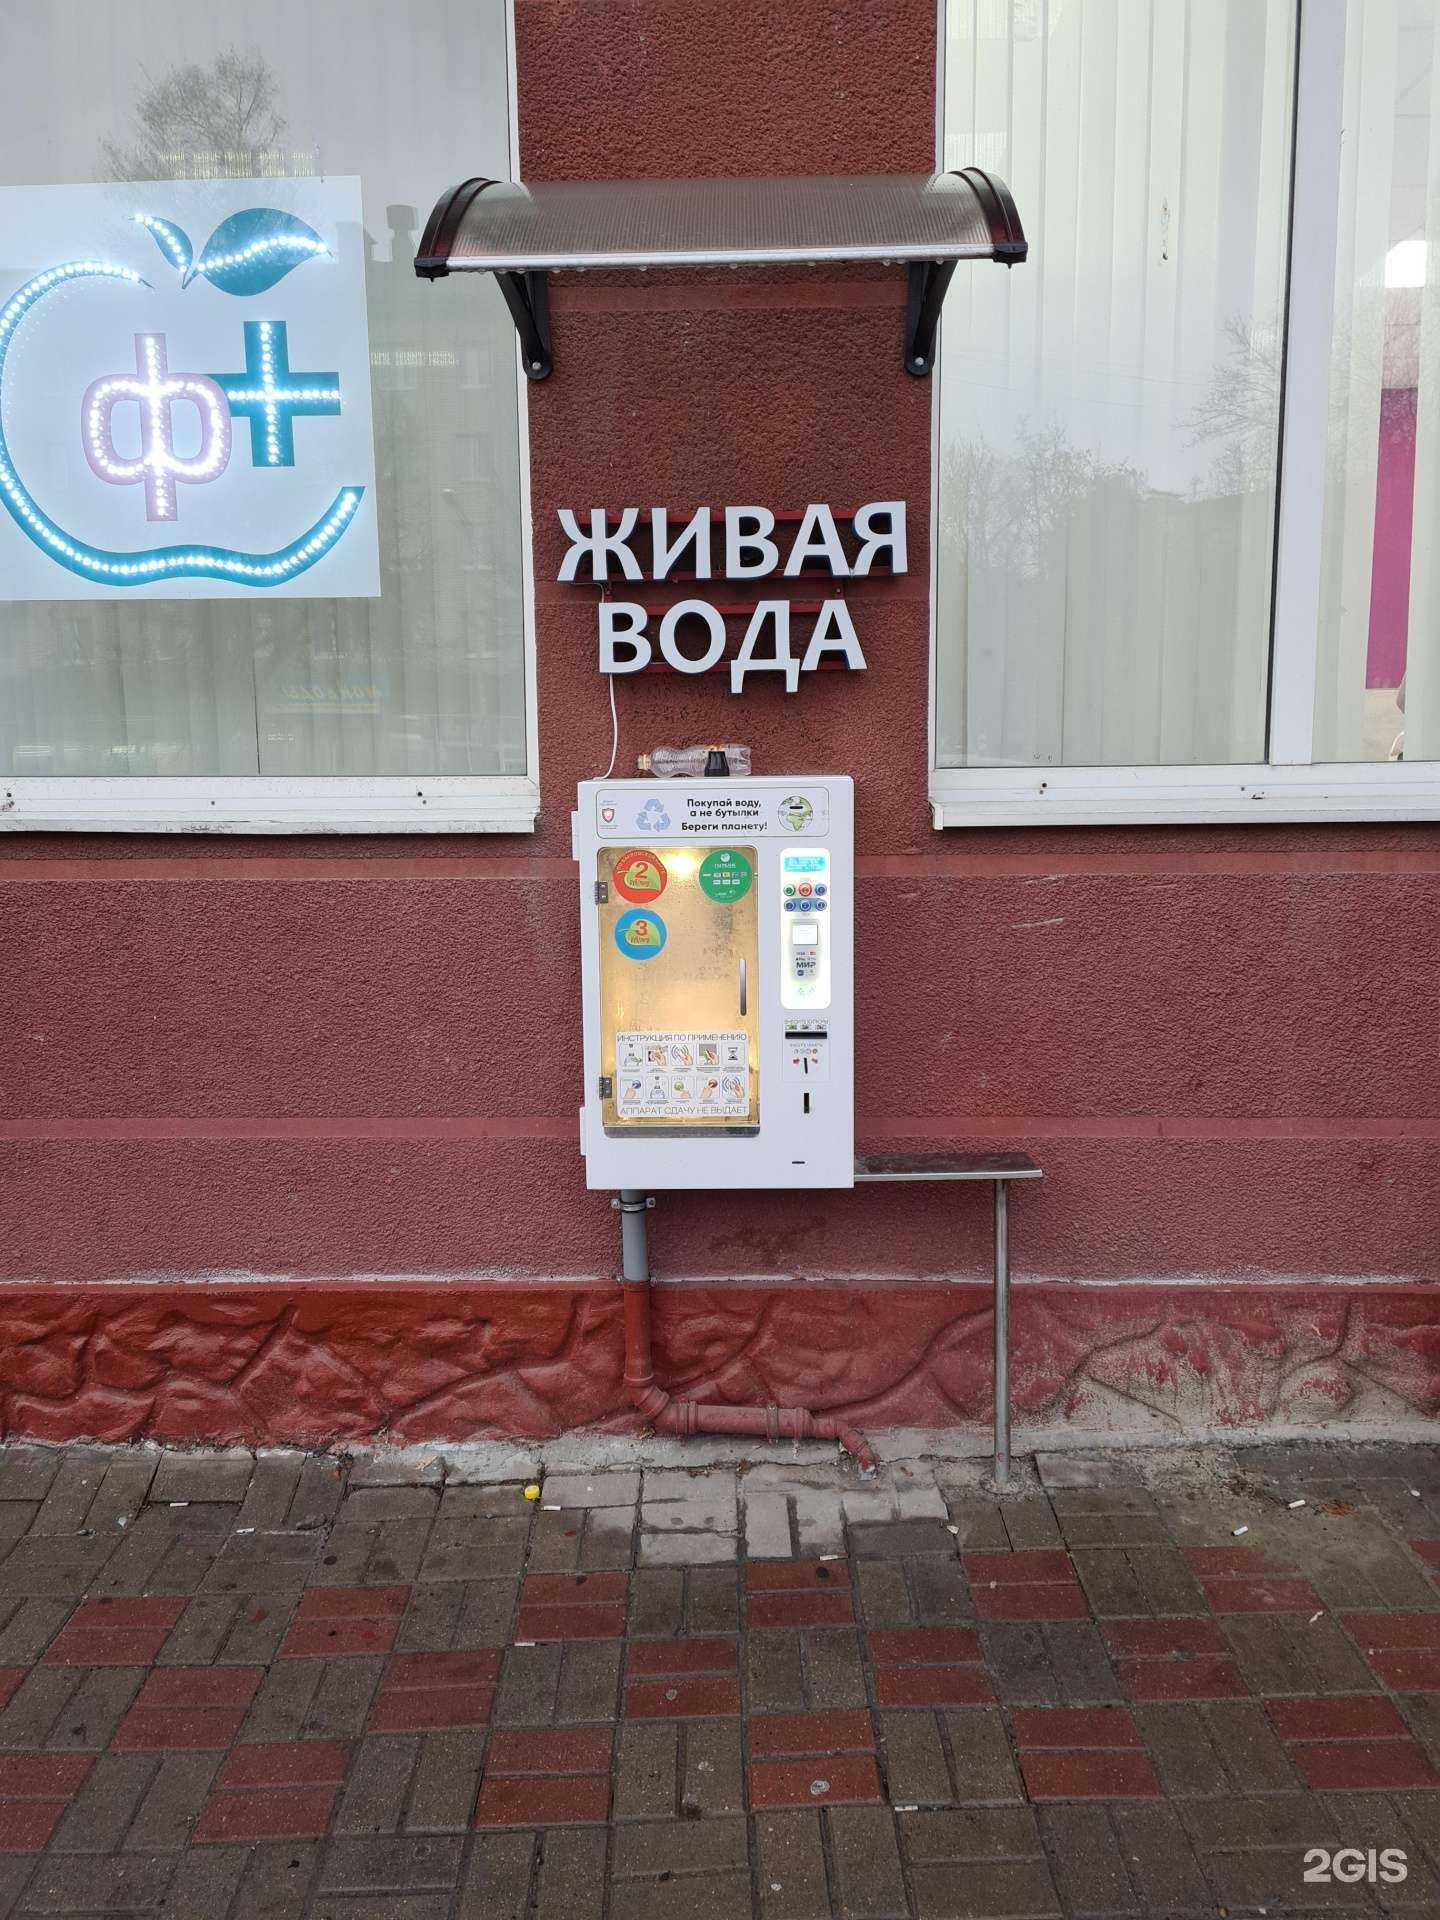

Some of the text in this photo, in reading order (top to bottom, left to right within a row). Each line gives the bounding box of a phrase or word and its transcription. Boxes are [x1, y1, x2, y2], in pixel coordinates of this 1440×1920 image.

[556, 501, 908, 583] ЖИВАЯ
[598, 599, 868, 693] ВОДА
[687, 798, 761, 808] Покупай воду,
[715, 809, 759, 818] бутылки
[681, 821, 768, 832] Береги планету!
[634, 862, 649, 879] 2
[635, 920, 648, 936] 3
[617, 1034, 673, 1042] ИНСТРУКЦИЯ
[687, 1033, 747, 1041] ПРИМЕНЕНИЮ
[710, 1106, 747, 1114] ВЫДАЕТ
